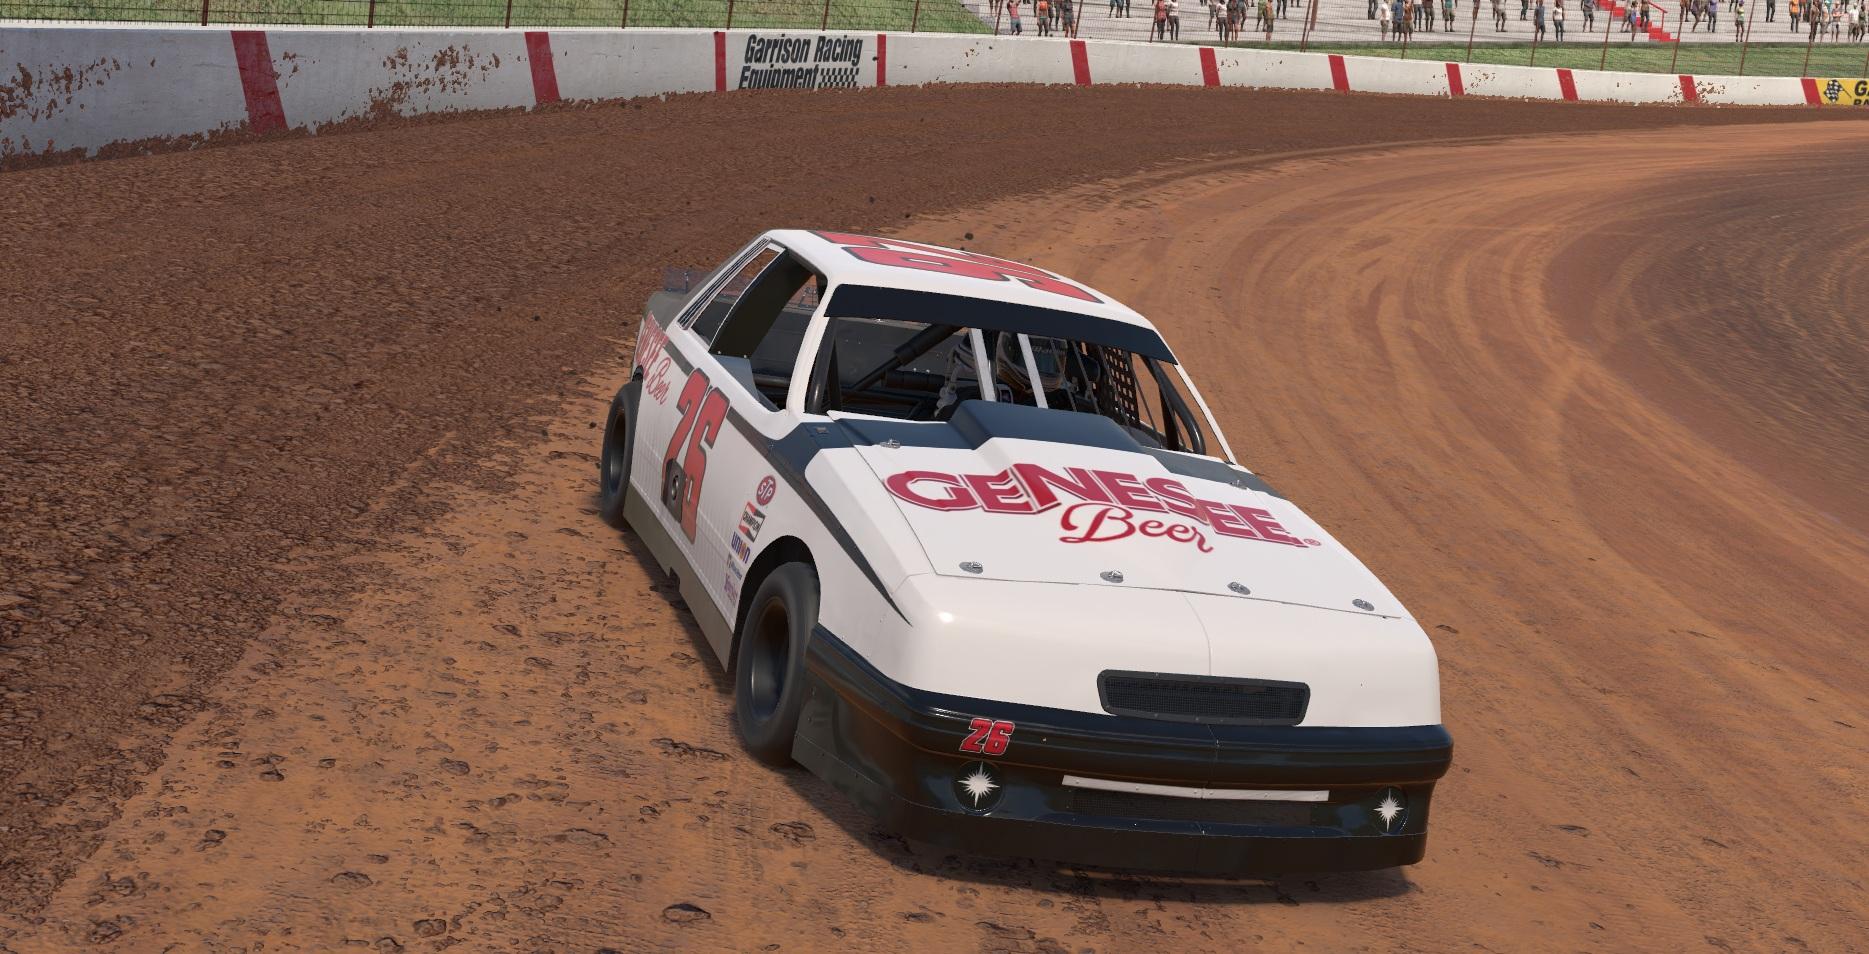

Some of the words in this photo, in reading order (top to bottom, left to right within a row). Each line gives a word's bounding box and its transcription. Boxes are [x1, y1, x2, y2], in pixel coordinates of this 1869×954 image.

[744, 34, 811, 64] Garrison
[813, 35, 863, 67] Racing
[738, 64, 819, 90] Equipment
[661, 368, 730, 545] 26
[882, 463, 1309, 548] GENESEE
[1059, 502, 1214, 553] Beer
[959, 717, 1016, 756] 26
